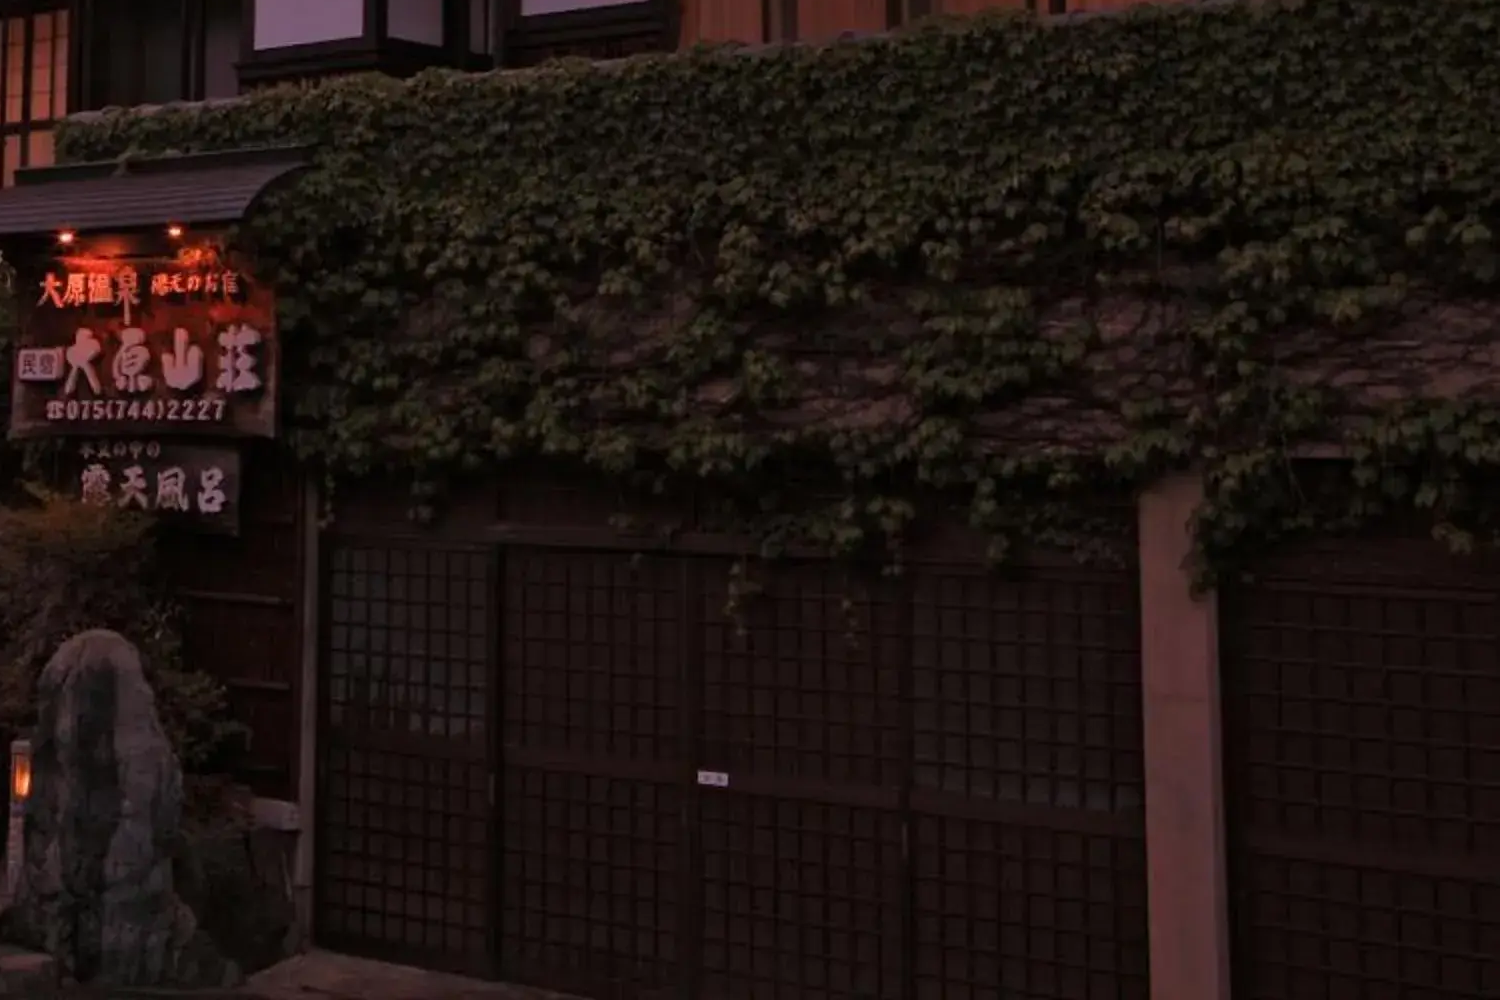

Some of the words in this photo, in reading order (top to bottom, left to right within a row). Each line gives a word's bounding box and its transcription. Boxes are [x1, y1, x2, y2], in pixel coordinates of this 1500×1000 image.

[36, 265, 141, 326] 大原温泉
[64, 323, 263, 395] 大原山荘
[80, 463, 229, 515] 露天風呂
